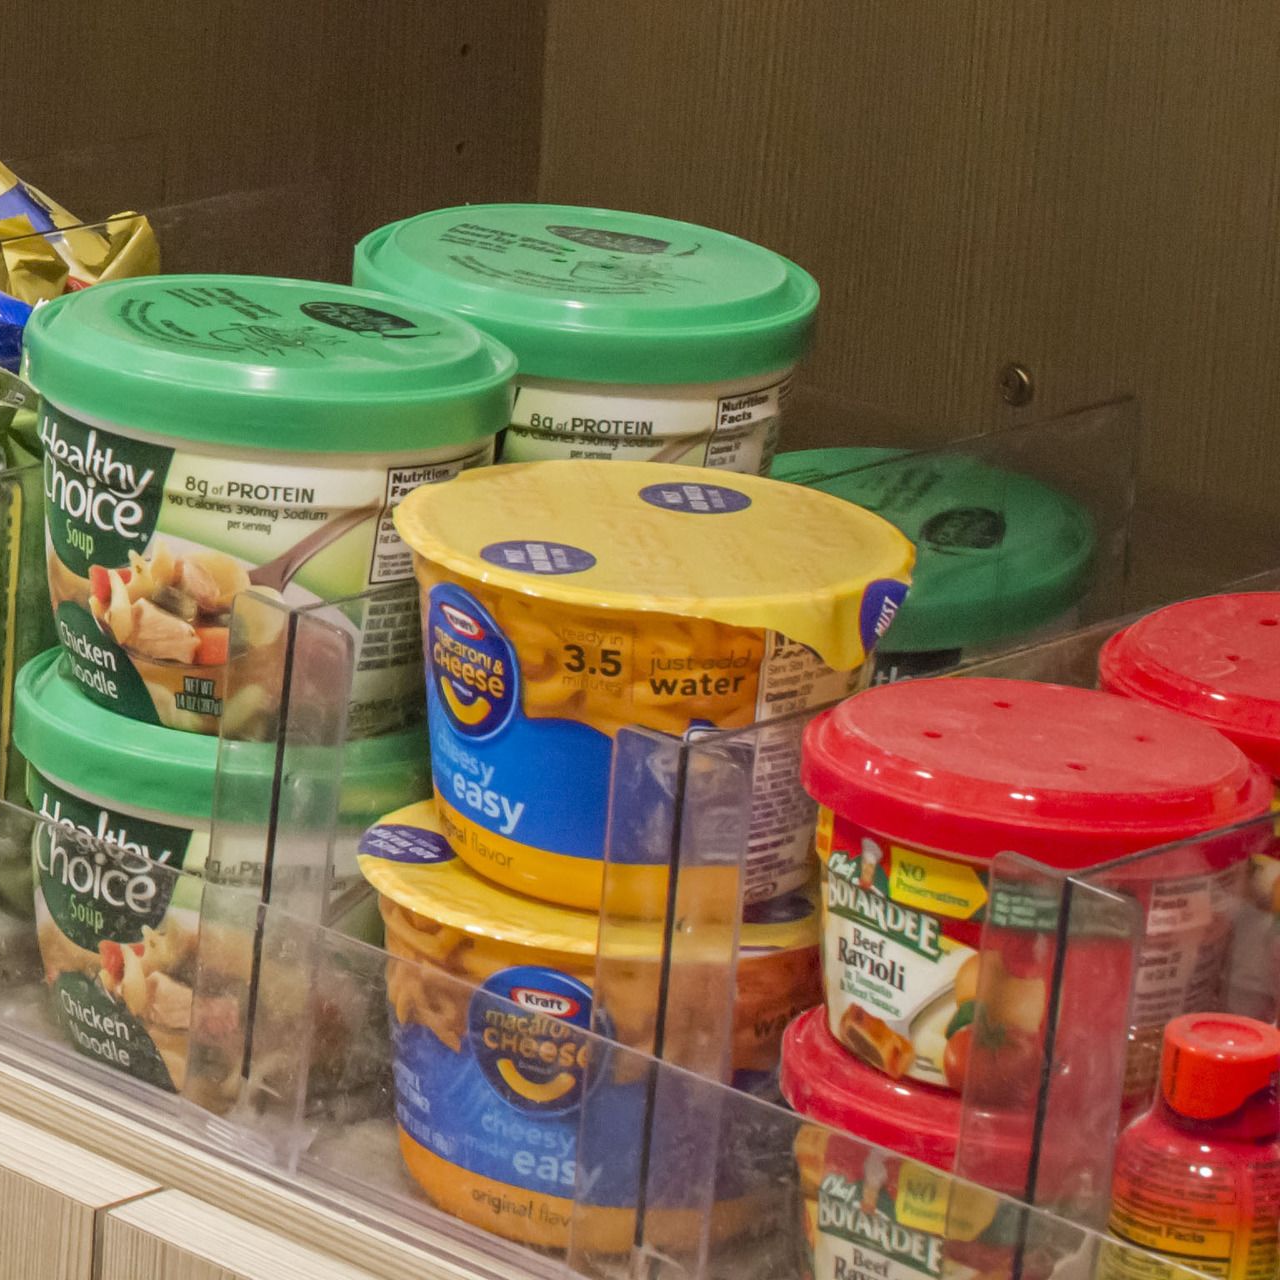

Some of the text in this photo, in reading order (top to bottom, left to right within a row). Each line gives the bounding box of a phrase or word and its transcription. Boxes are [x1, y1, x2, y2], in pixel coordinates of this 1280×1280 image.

[720, 409, 752, 426] Facts
[721, 393, 769, 413] Nutrition
[530, 413, 653, 436] 8g of PROTEIN
[40, 415, 155, 499] Healthy
[185, 475, 315, 504] 8g of PROTEIN
[392, 469, 450, 485] Nutrition
[43, 449, 144, 539] Choice
[168, 494, 329, 522] 90 Calories 390mg Sodium
[66, 518, 94, 561] Soup
[227, 520, 272, 535] per serving
[874, 595, 899, 636] MUST
[60, 620, 117, 673] Chicken
[434, 624, 504, 676] macaroni &
[559, 627, 624, 647] ready in
[564, 643, 623, 677] 3.5
[650, 649, 752, 675] just add
[184, 677, 214, 695] NET WT
[561, 673, 624, 691] minutes
[649, 673, 745, 696] water
[175, 693, 185, 709] 14
[452, 771, 525, 835] easy
[470, 830, 515, 870] flavor
[36, 821, 156, 914] Choice
[899, 860, 926, 882] NO
[896, 879, 970, 908] Preservatives
[70, 893, 104, 934] Soup
[827, 868, 941, 956] BOYARDEE
[853, 927, 886, 958] Beef
[838, 936, 906, 992] Ravioli
[846, 981, 902, 1018] Meat Sauce
[855, 972, 893, 999] Tomato
[60, 988, 130, 1041] Chicken
[524, 991, 564, 1012] Kraft
[485, 1007, 570, 1038] macaro
[69, 1019, 130, 1067] Noodle
[481, 1111, 576, 1158] cheesy
[512, 1150, 603, 1195] easy
[471, 1188, 534, 1219] original
[818, 1190, 945, 1273] BOYARDEE
[1166, 1227, 1206, 1243] Facts
[852, 1247, 889, 1278] Beef
